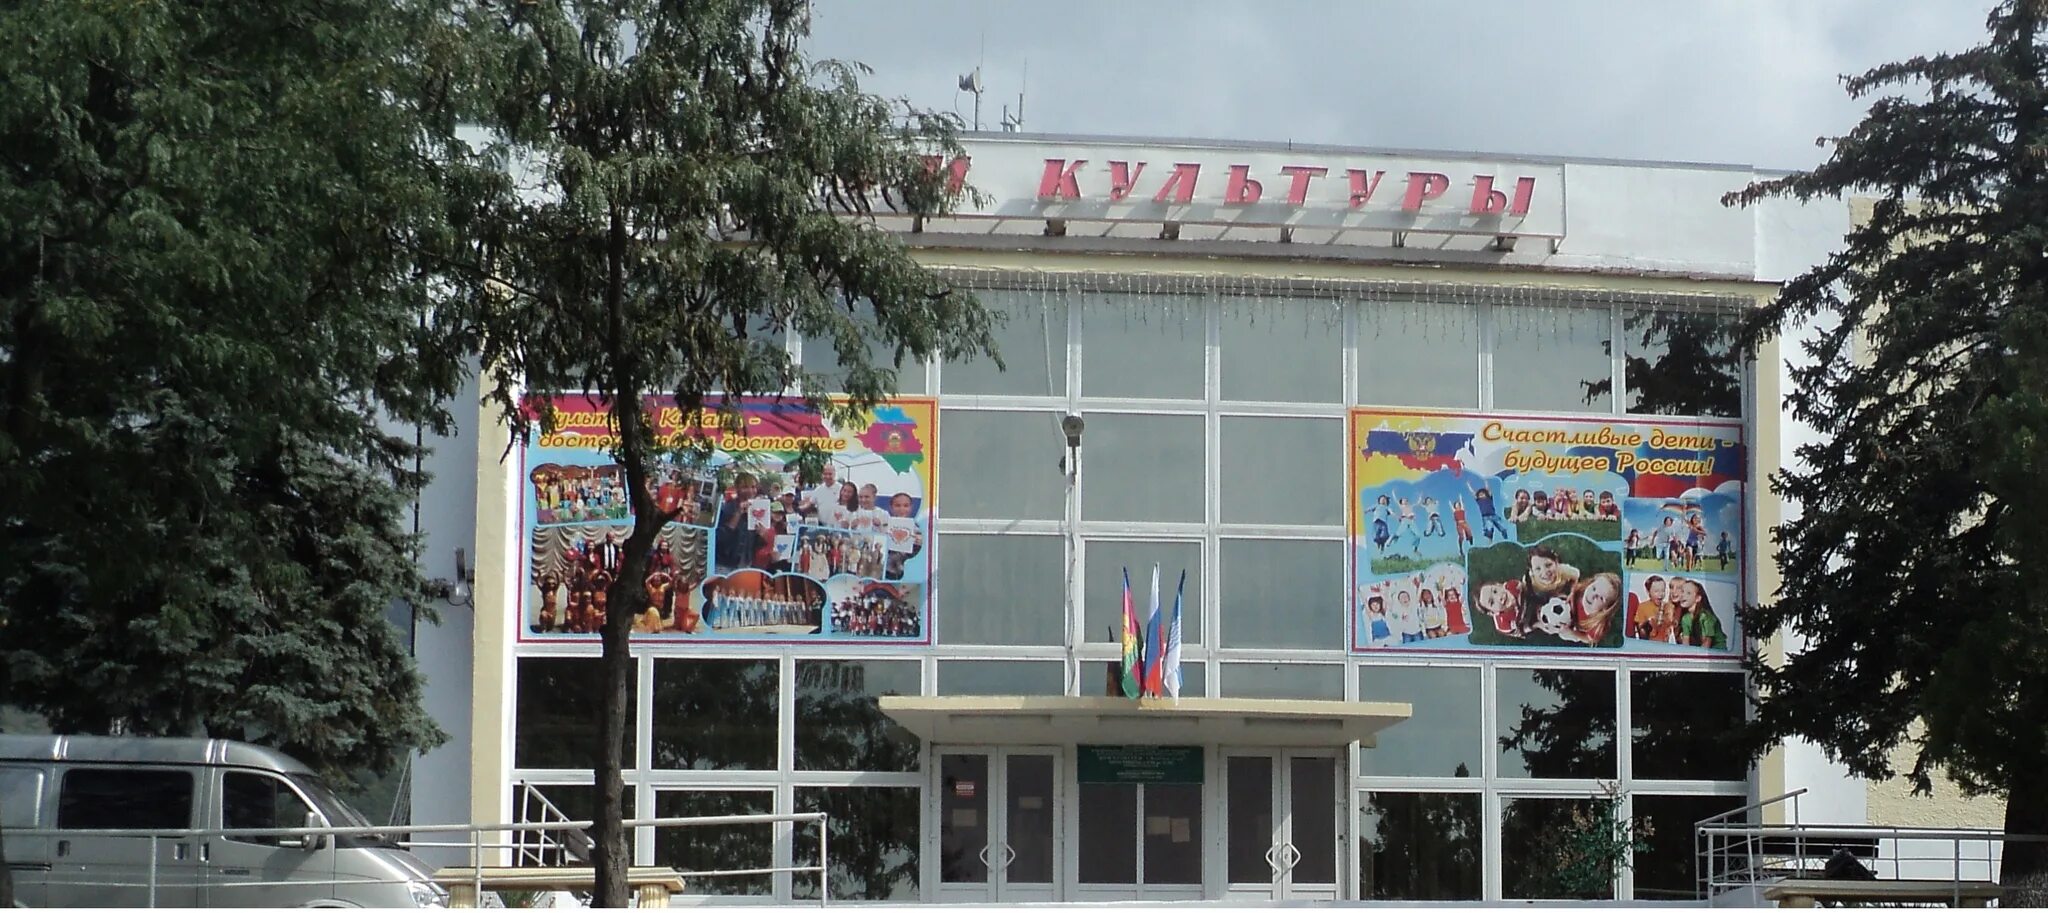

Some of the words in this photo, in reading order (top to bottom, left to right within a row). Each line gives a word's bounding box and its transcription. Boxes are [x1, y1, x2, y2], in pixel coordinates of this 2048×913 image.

[1037, 158, 1536, 217] КУЛЬТУРЫ
[1482, 422, 1641, 447] Счастливые
[1651, 428, 1717, 449] дети
[1504, 449, 1609, 475] будущее
[1617, 452, 1715, 474] России!
